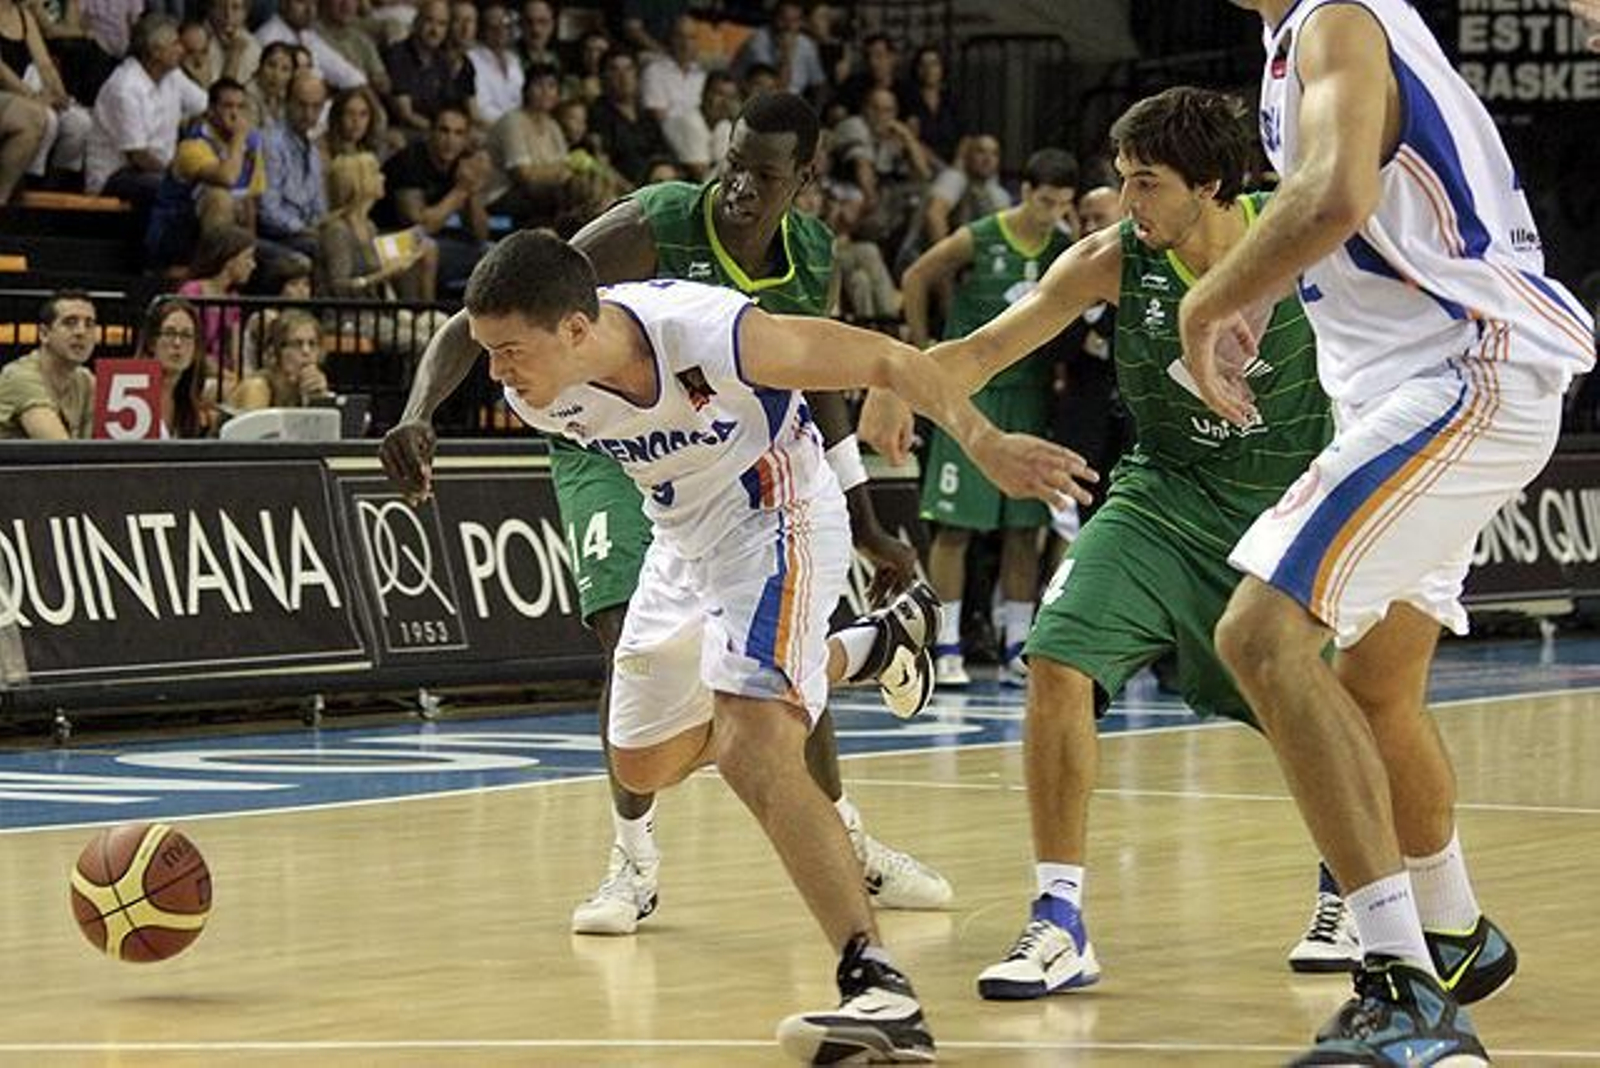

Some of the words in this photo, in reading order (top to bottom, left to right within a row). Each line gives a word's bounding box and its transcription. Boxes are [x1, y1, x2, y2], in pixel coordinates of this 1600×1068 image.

[105, 374, 152, 440] 5
[938, 462, 959, 495] 6
[568, 511, 613, 574] 14
[400, 621, 449, 644] 1953
